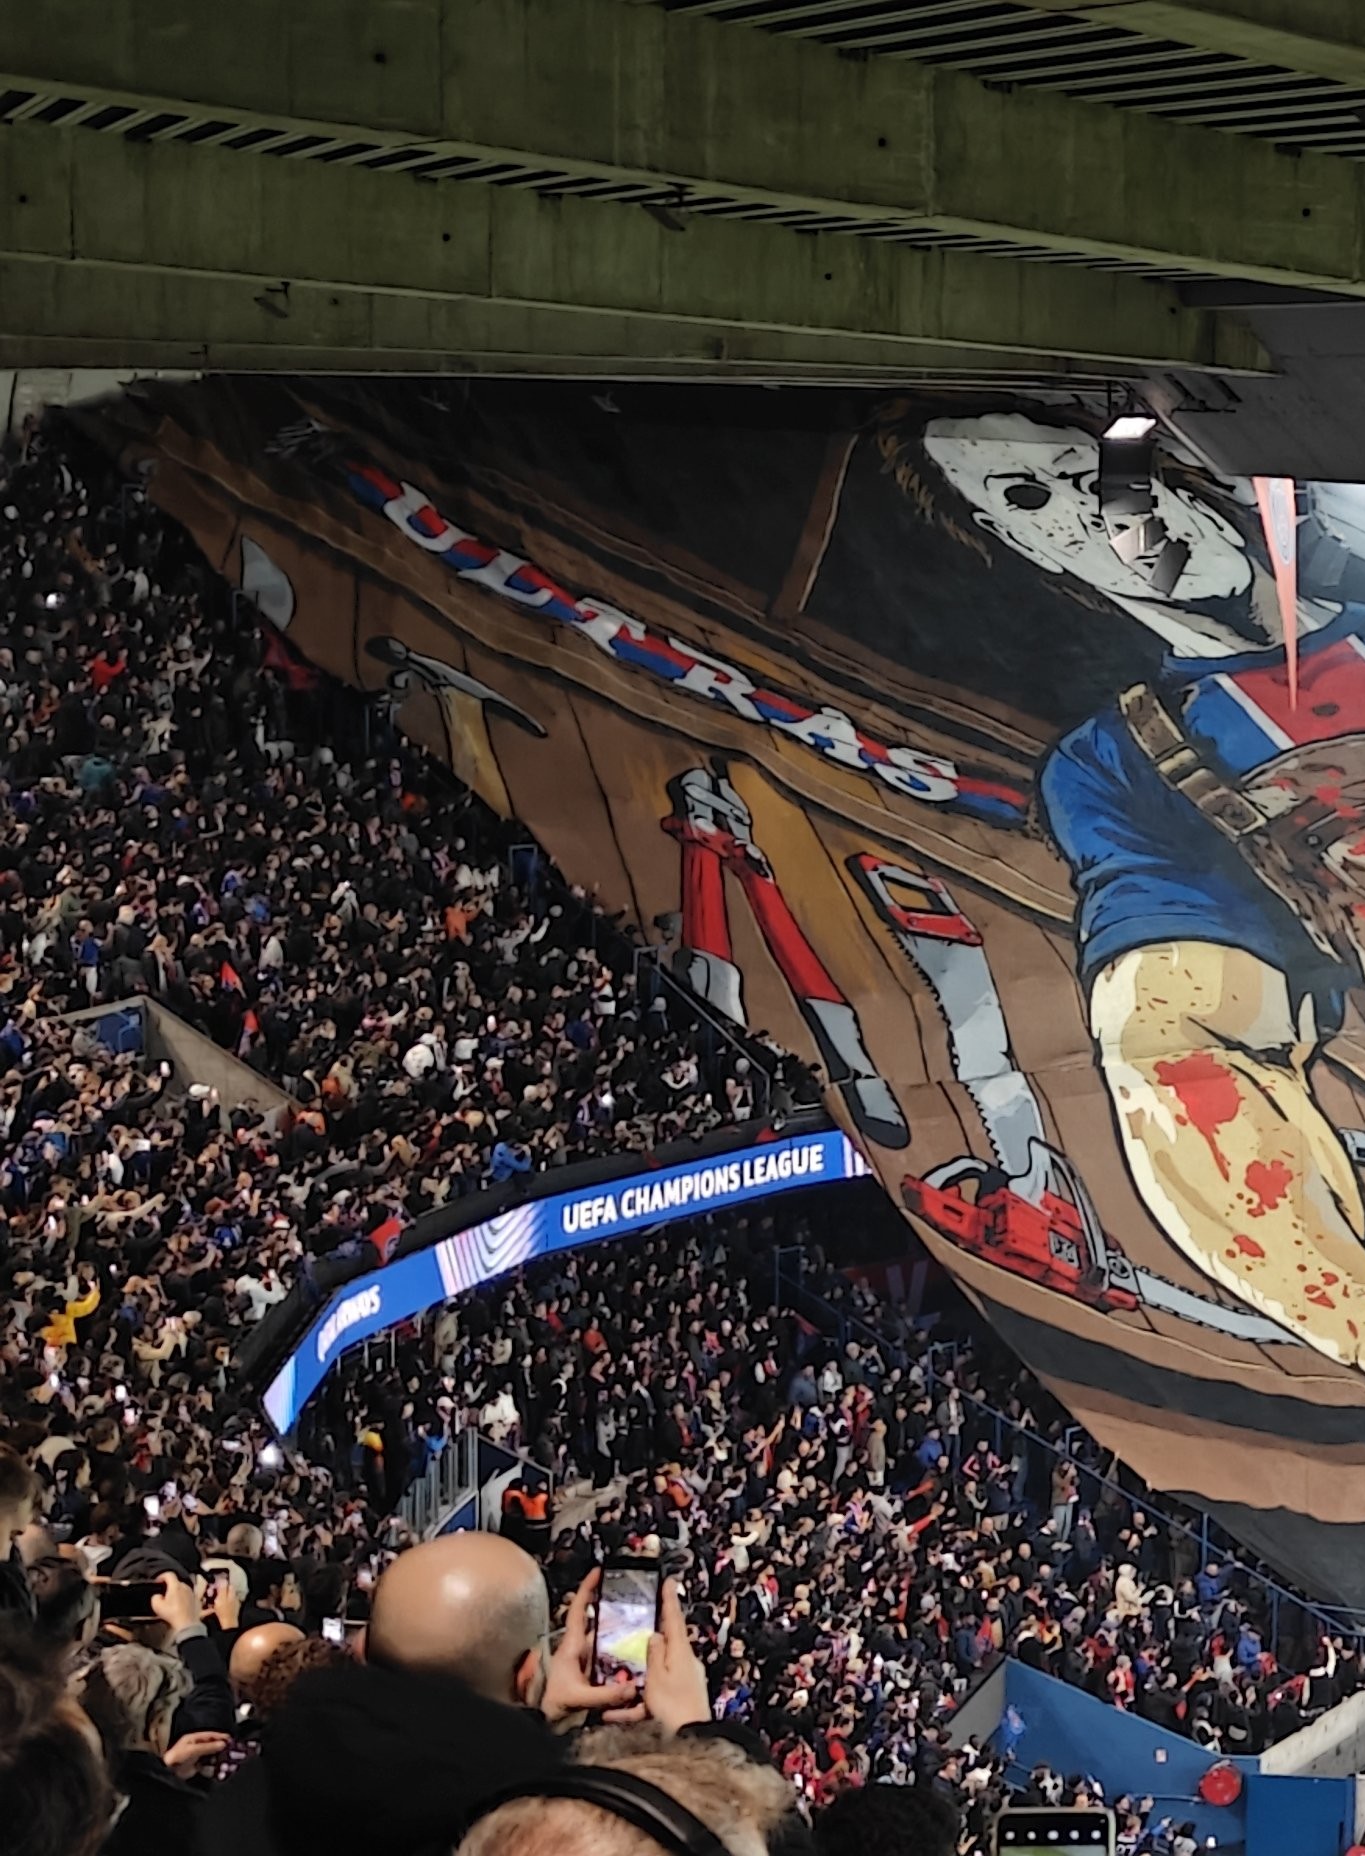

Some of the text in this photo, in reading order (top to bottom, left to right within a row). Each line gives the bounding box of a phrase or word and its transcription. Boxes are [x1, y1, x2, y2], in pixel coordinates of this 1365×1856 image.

[384, 480, 958, 802] ULTRAS
[562, 1143, 825, 1234] UEFA CHAMPIONS LEAGUE
